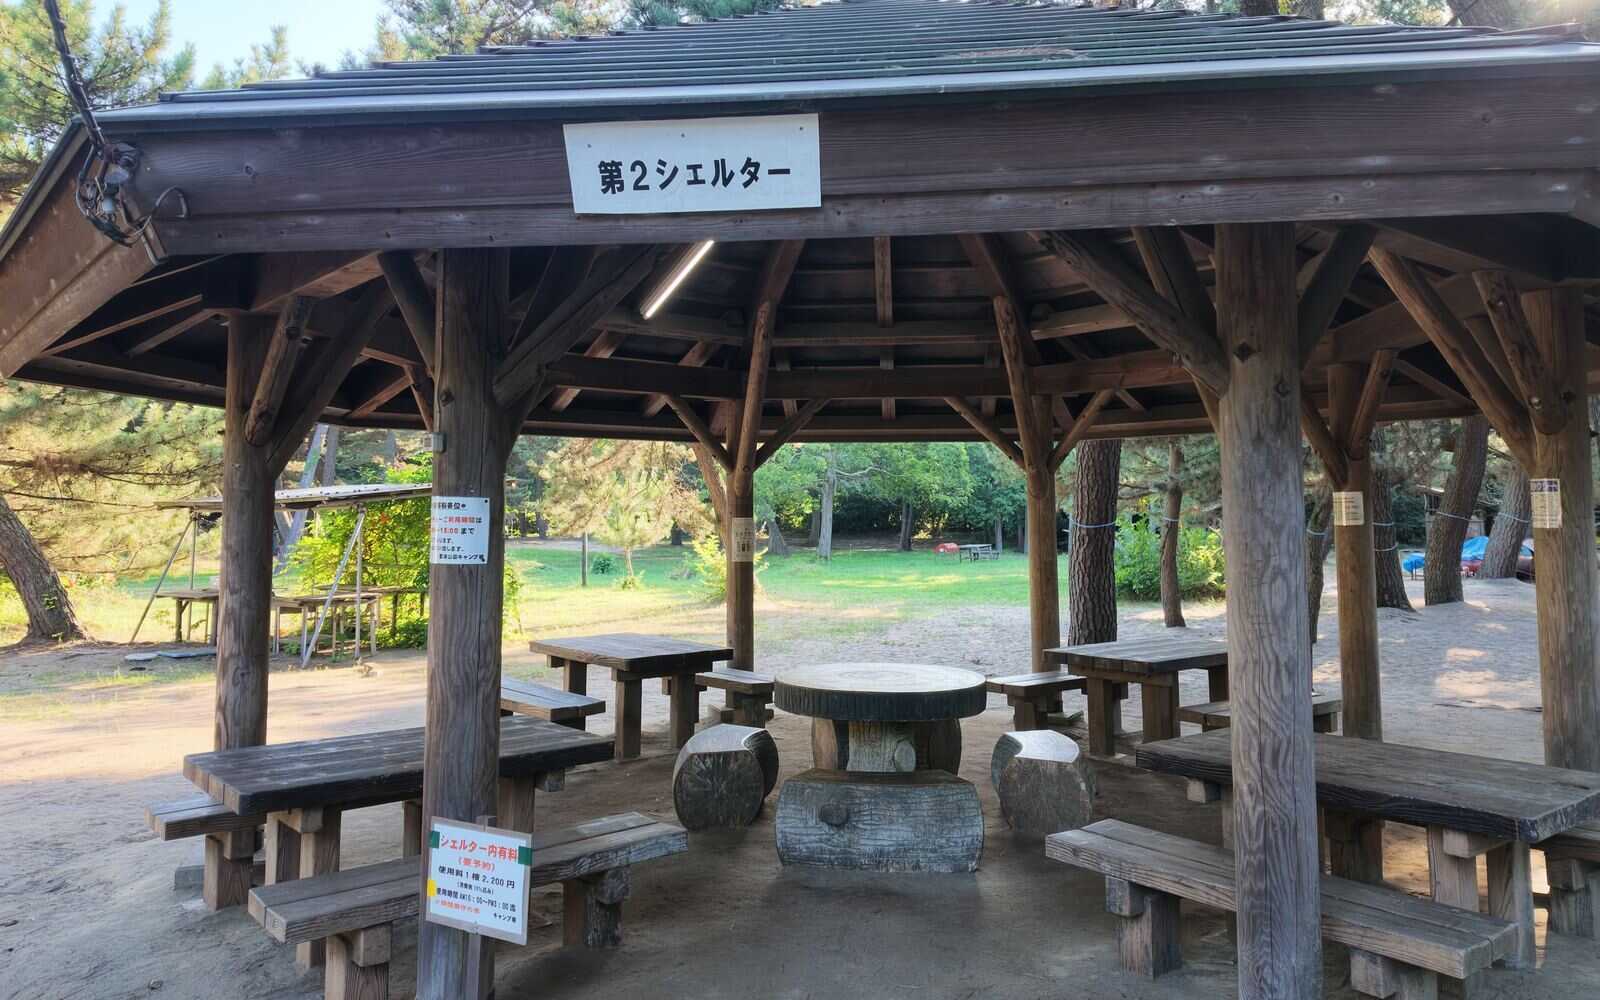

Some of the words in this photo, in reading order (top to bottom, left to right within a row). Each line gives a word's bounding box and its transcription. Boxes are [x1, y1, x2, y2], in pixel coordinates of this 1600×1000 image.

[598, 156, 791, 195] 第2シェルター
[441, 835, 518, 862] シェルター内有料
